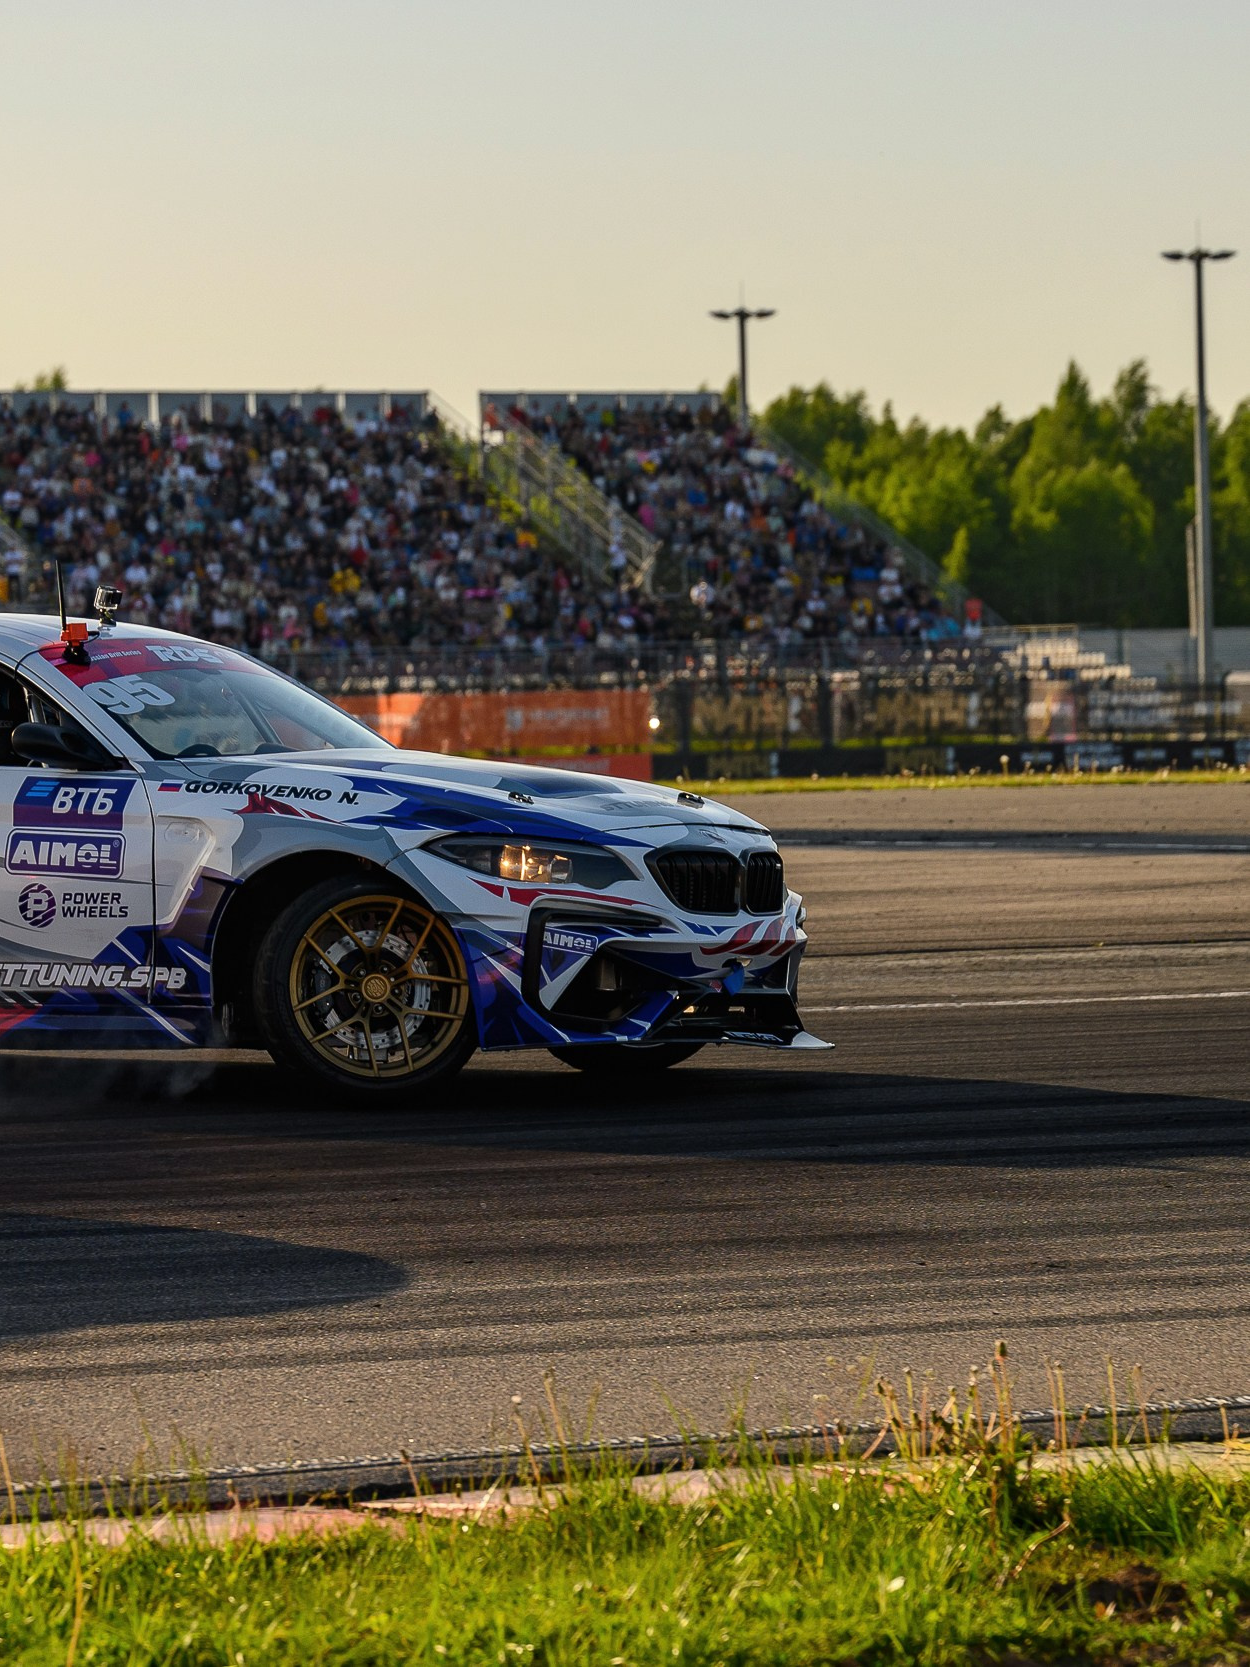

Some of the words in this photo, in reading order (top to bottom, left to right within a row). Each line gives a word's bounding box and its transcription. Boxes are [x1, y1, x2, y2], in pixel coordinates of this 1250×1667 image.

[82, 675, 176, 715] 95
[52, 786, 118, 815] ВТБ
[184, 779, 333, 802] GORKOVENKO
[338, 792, 360, 805] N.
[11, 840, 117, 869] AIMOL
[61, 905, 129, 918] WHEELS
[62, 892, 122, 905] POWER
[543, 931, 595, 952] AIMOL
